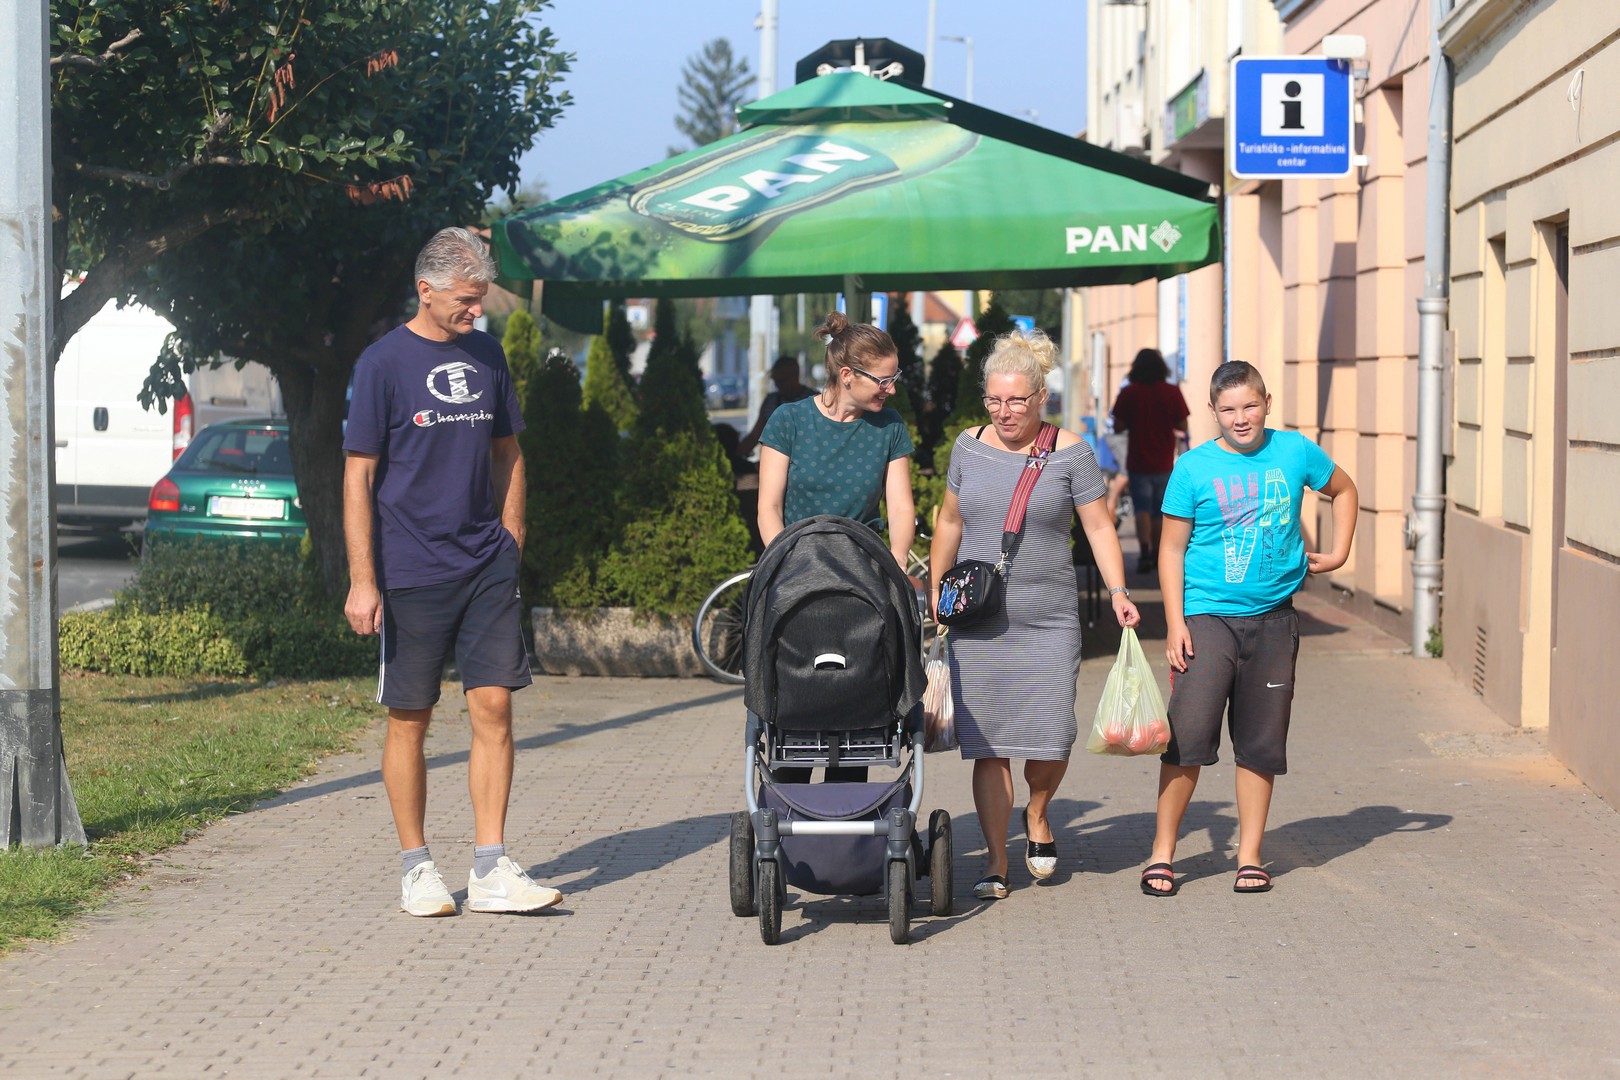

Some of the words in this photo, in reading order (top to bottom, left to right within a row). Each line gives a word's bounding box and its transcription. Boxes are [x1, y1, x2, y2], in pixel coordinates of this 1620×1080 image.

[680, 140, 871, 212] PAN
[1277, 157, 1306, 167] centar
[1065, 223, 1148, 255] PAN
